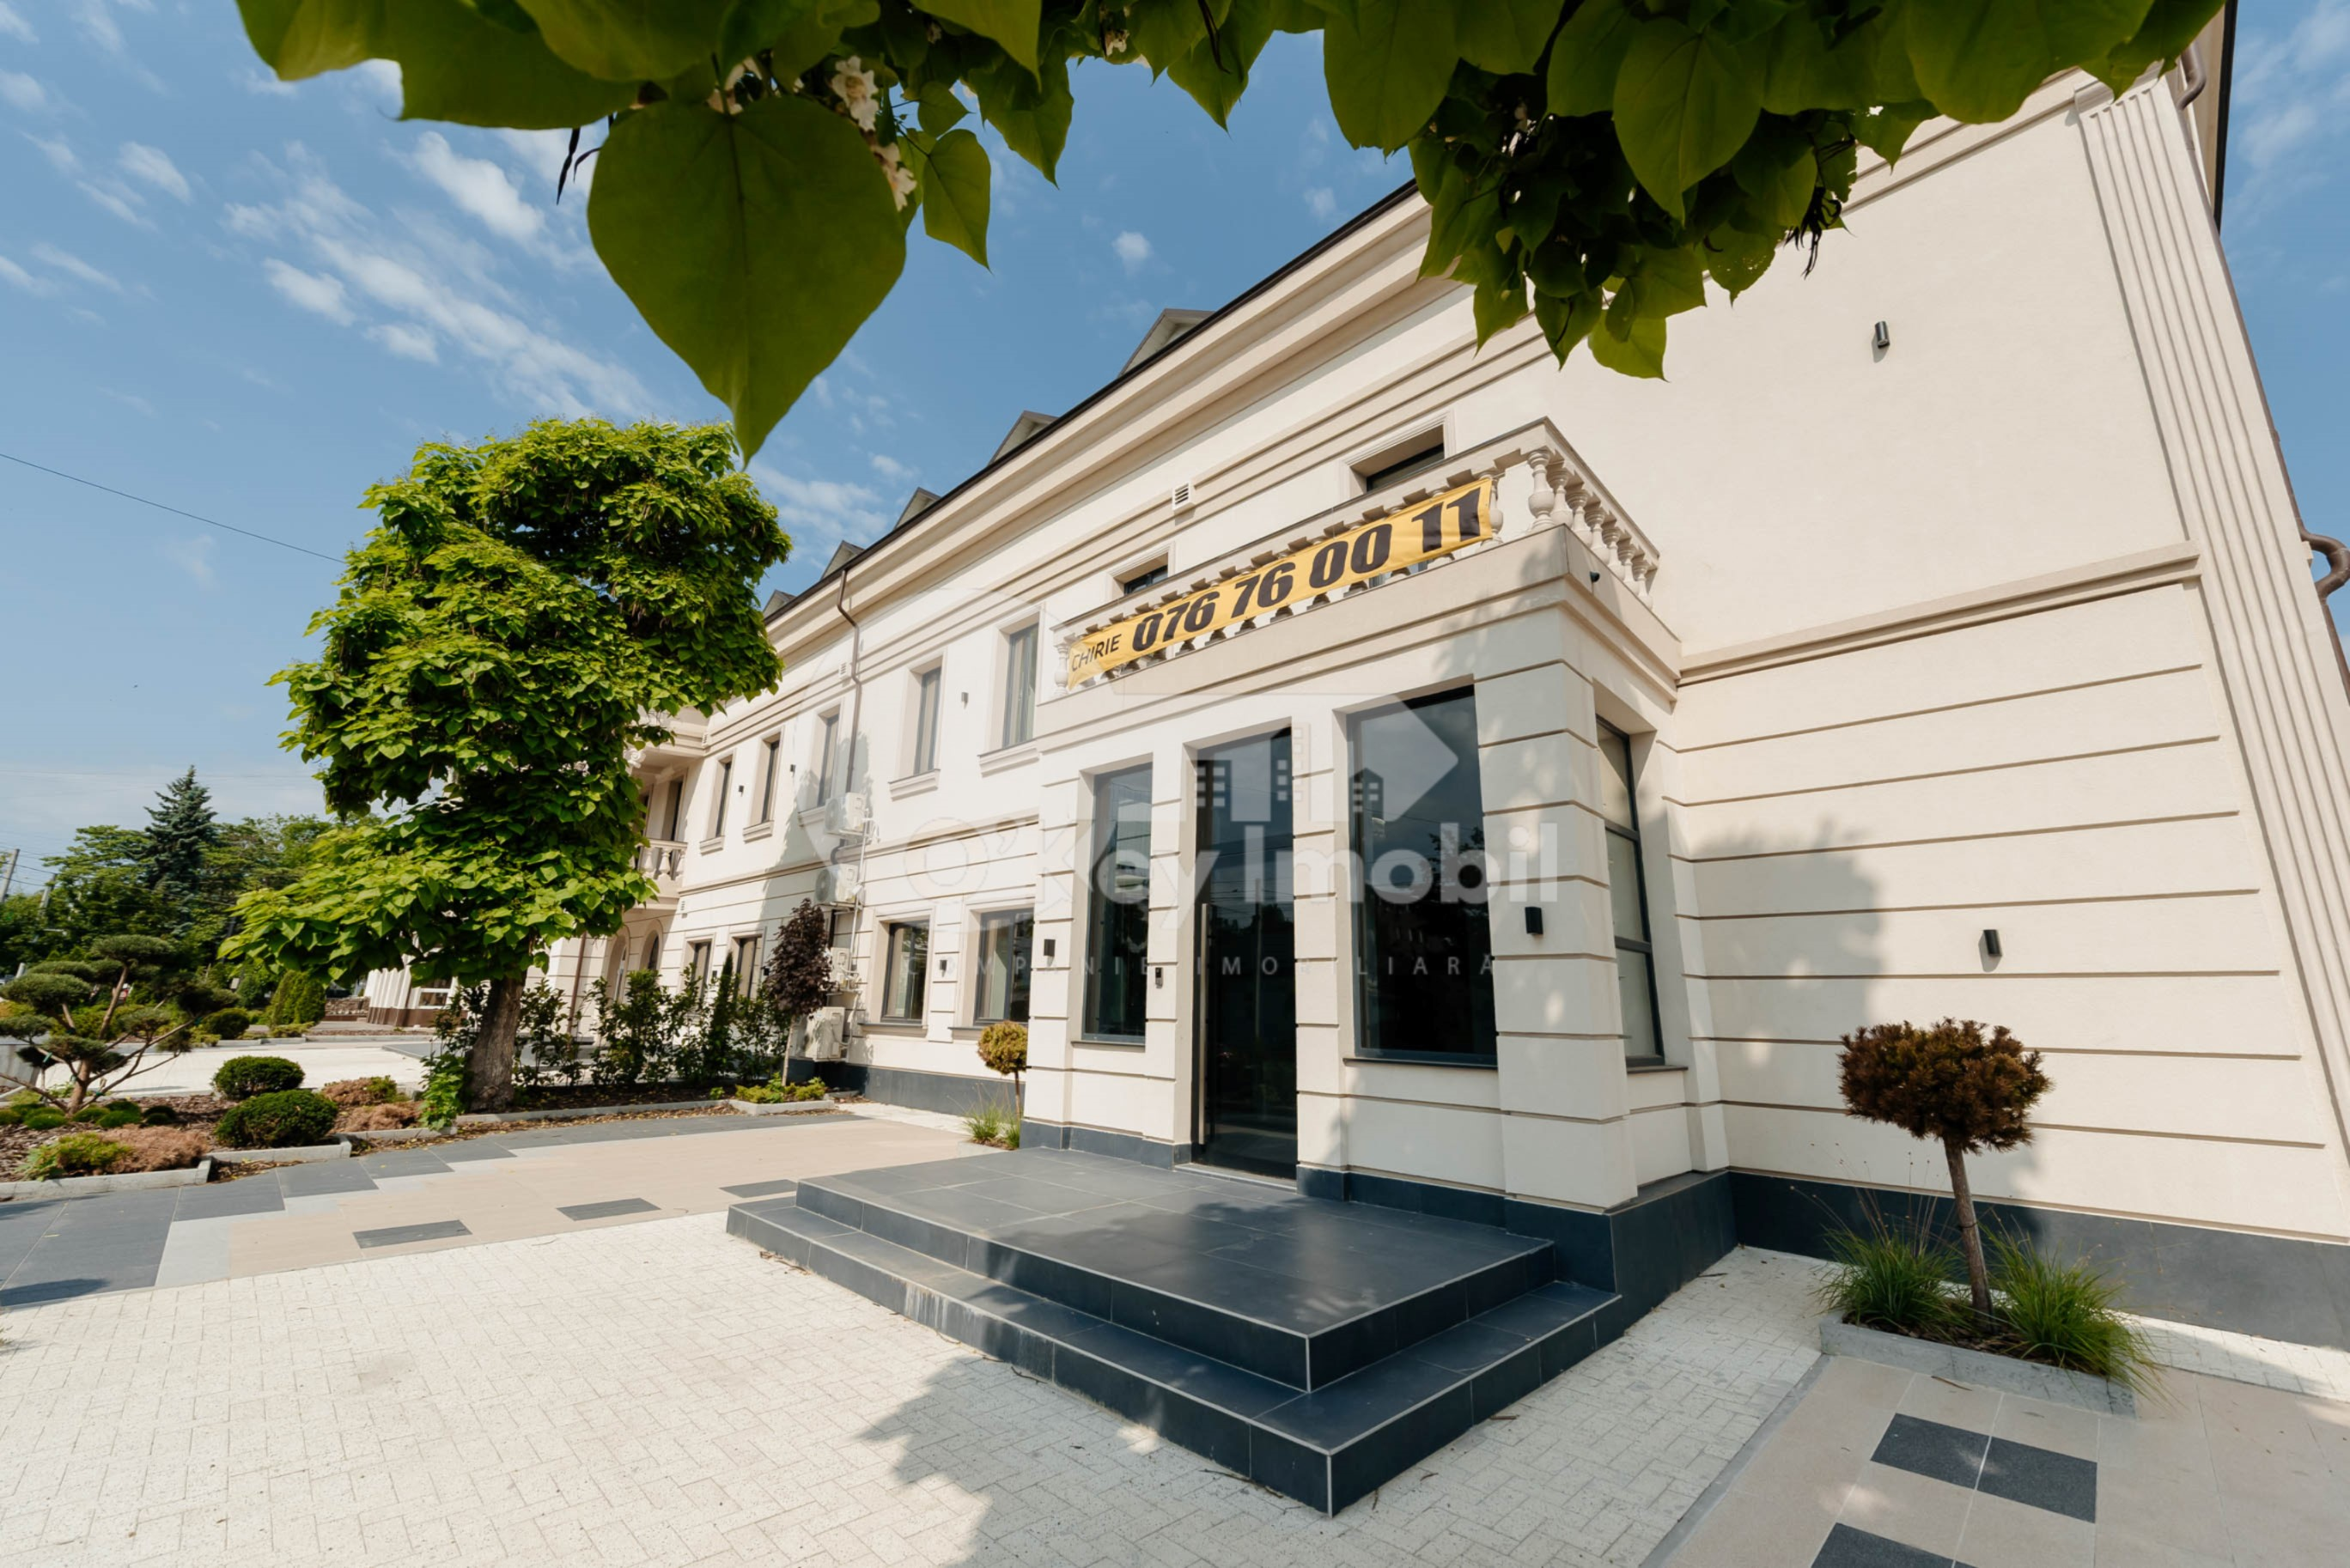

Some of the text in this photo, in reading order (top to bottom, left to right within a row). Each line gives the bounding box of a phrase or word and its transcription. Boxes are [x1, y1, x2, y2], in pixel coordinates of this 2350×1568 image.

[1071, 487, 1482, 672] CHIRIE 076 76 00 11
